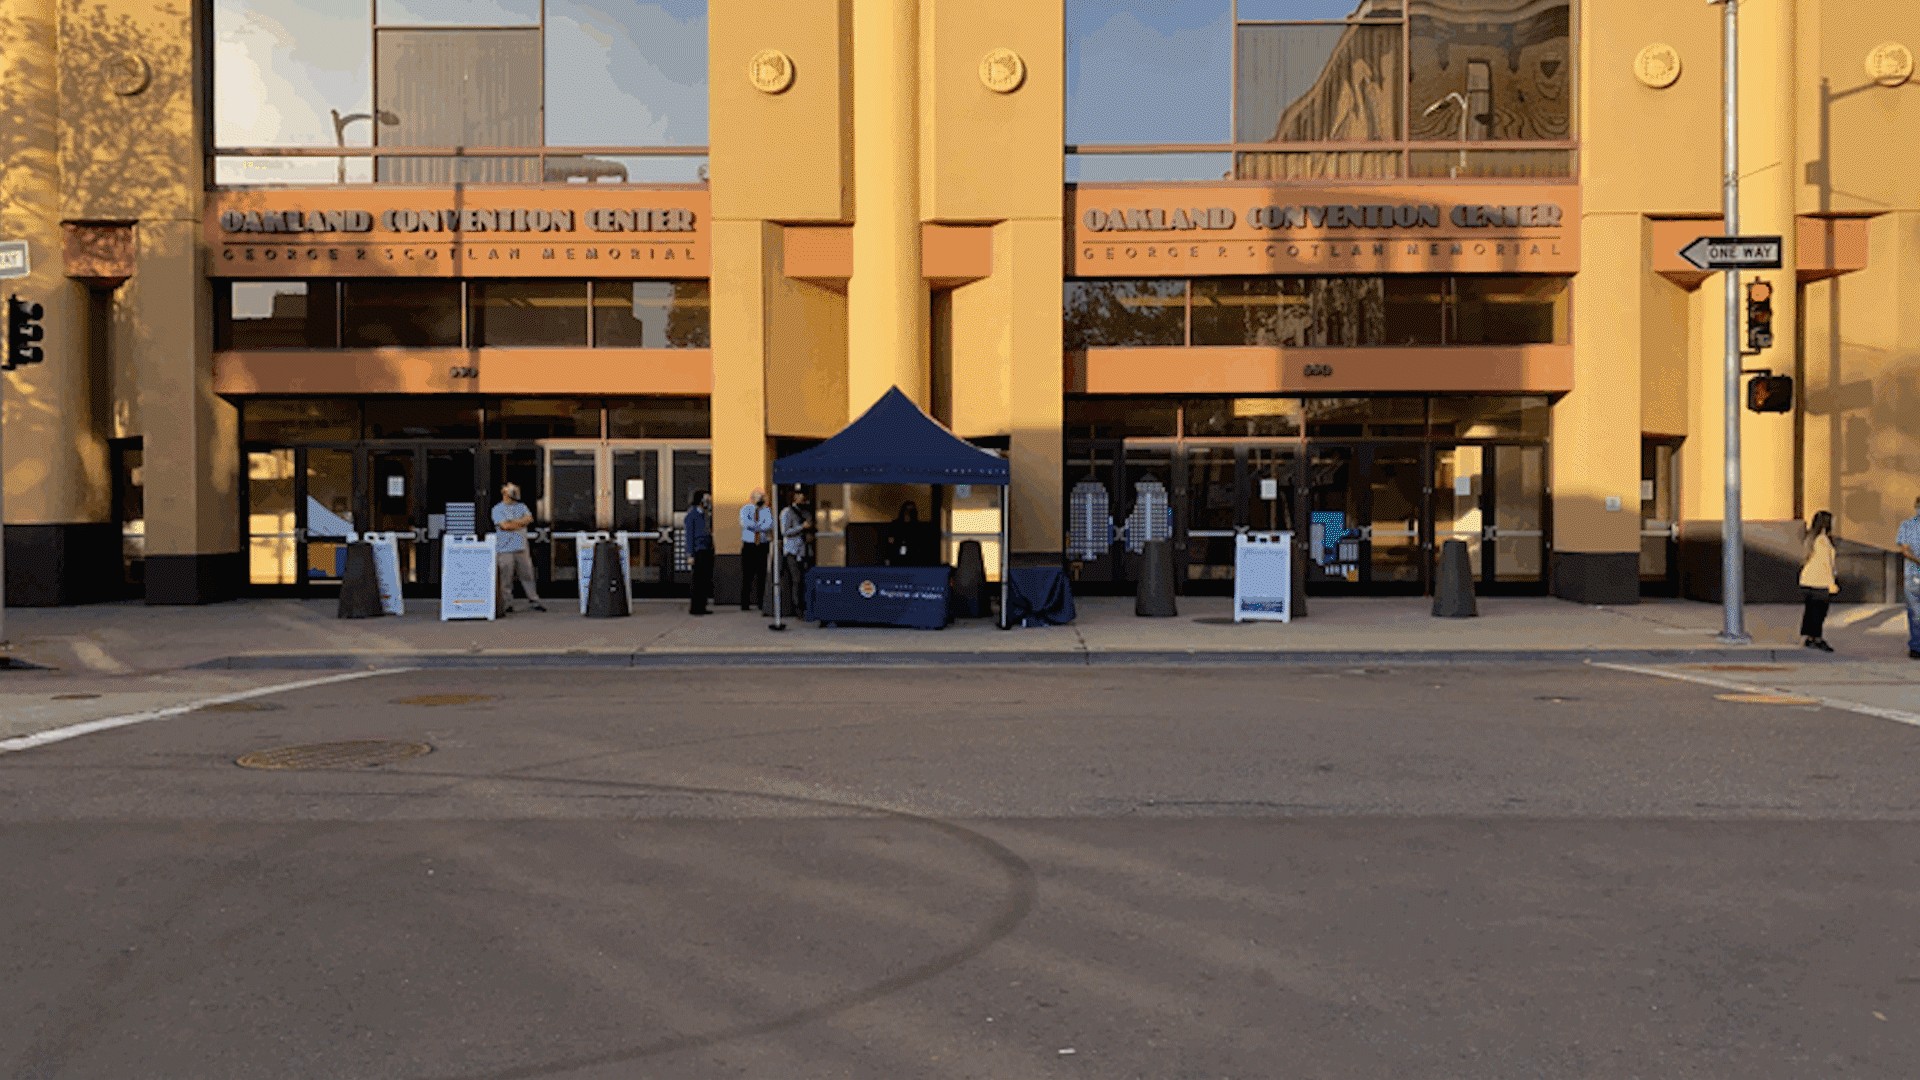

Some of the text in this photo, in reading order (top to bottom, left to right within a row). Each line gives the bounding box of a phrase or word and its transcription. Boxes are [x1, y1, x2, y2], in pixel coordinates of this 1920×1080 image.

[220, 208, 697, 232] OAKLAND CONVENTION CENTER
[1083, 203, 1563, 232] OAKLAND CONVENTION CENTER
[223, 248, 338, 261] GEORGE
[542, 248, 695, 260] MEMORIAL
[1083, 246, 1199, 260] GEORGE
[1407, 242, 1561, 257] MEMORIAL
[1710, 246, 1773, 259] ONE WAY
